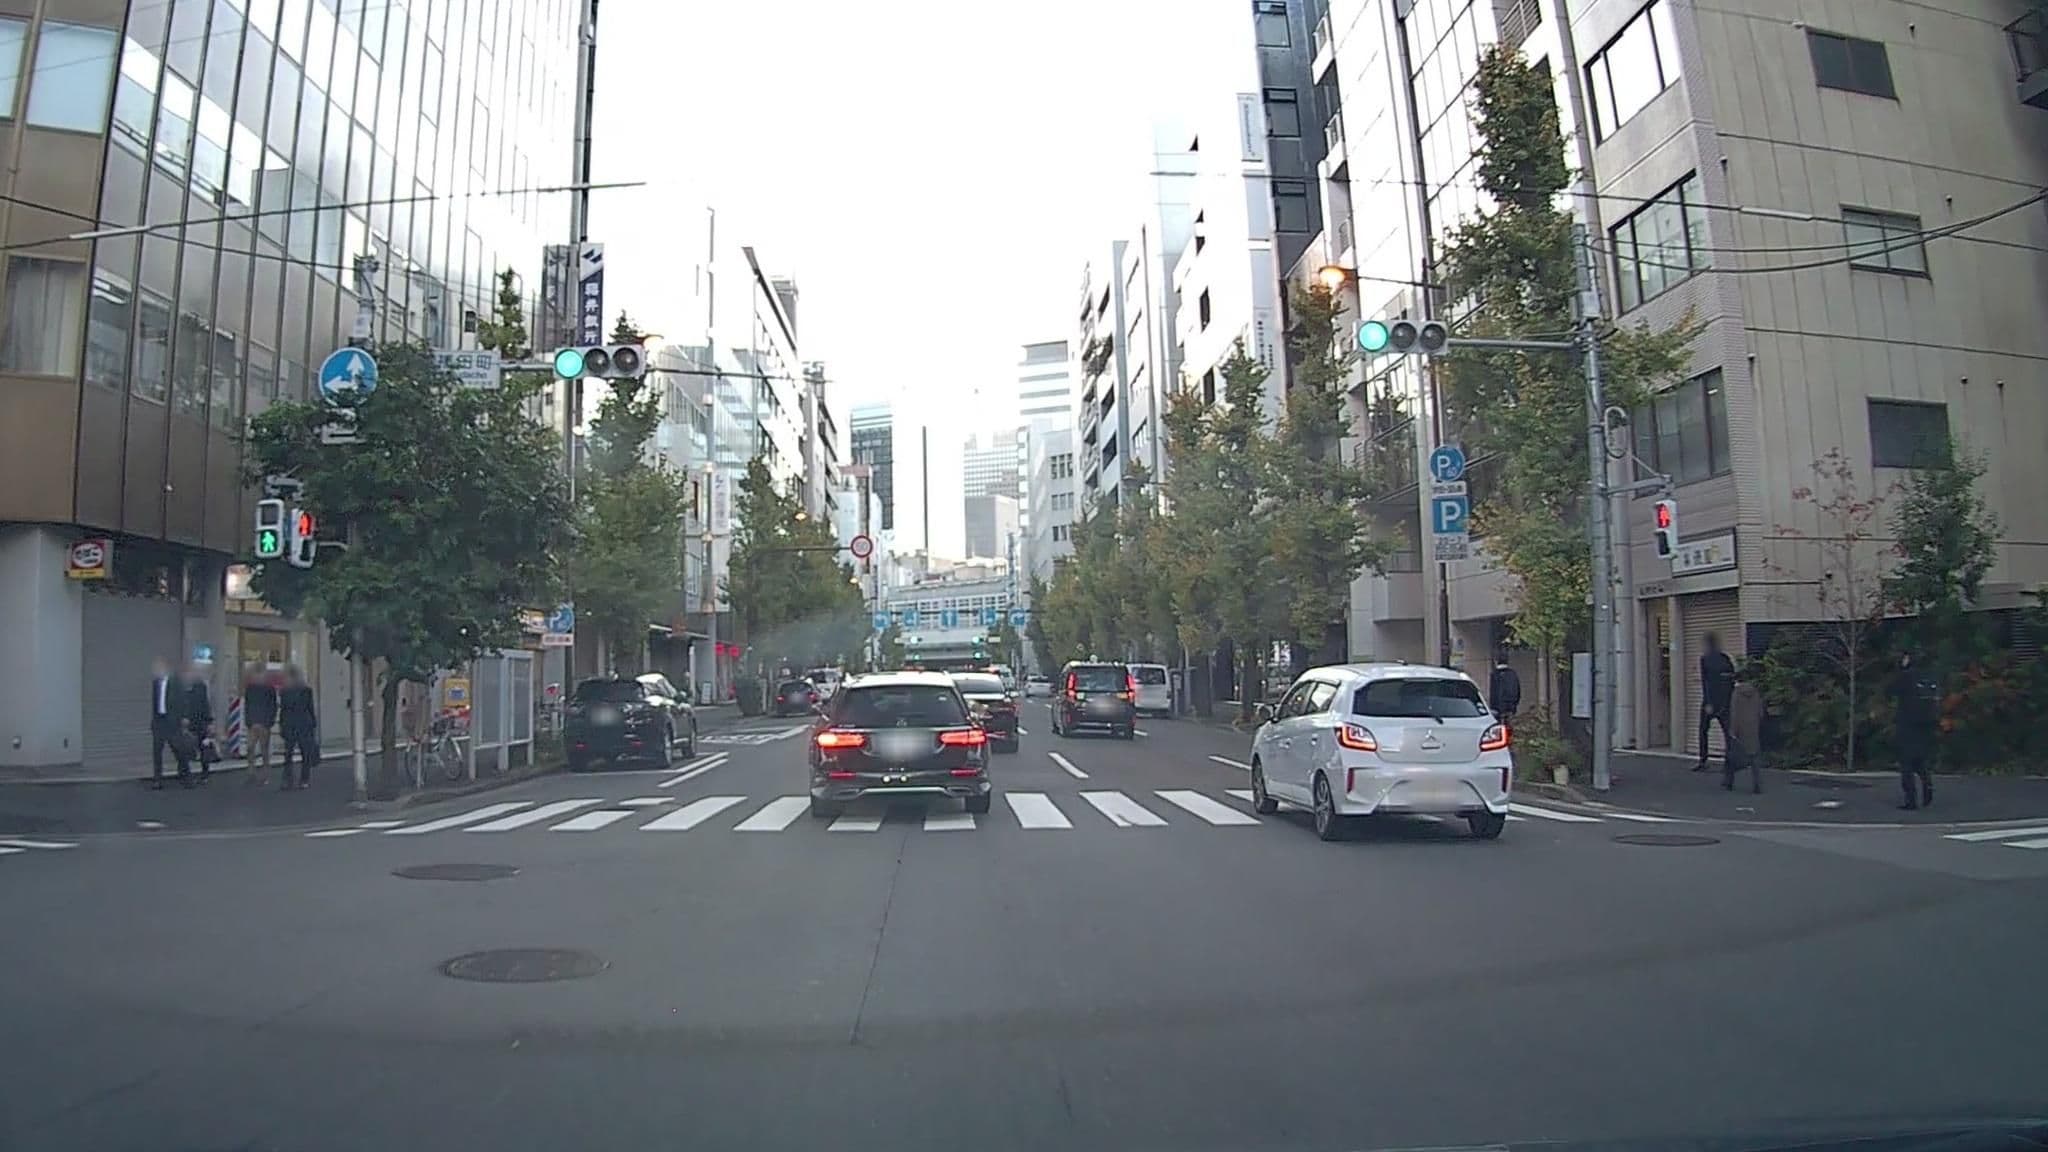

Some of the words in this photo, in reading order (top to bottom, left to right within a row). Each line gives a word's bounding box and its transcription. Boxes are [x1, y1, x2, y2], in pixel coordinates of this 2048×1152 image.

[1437, 455, 1450, 477] P
[1441, 500, 1460, 531] P
[549, 611, 562, 629] P
